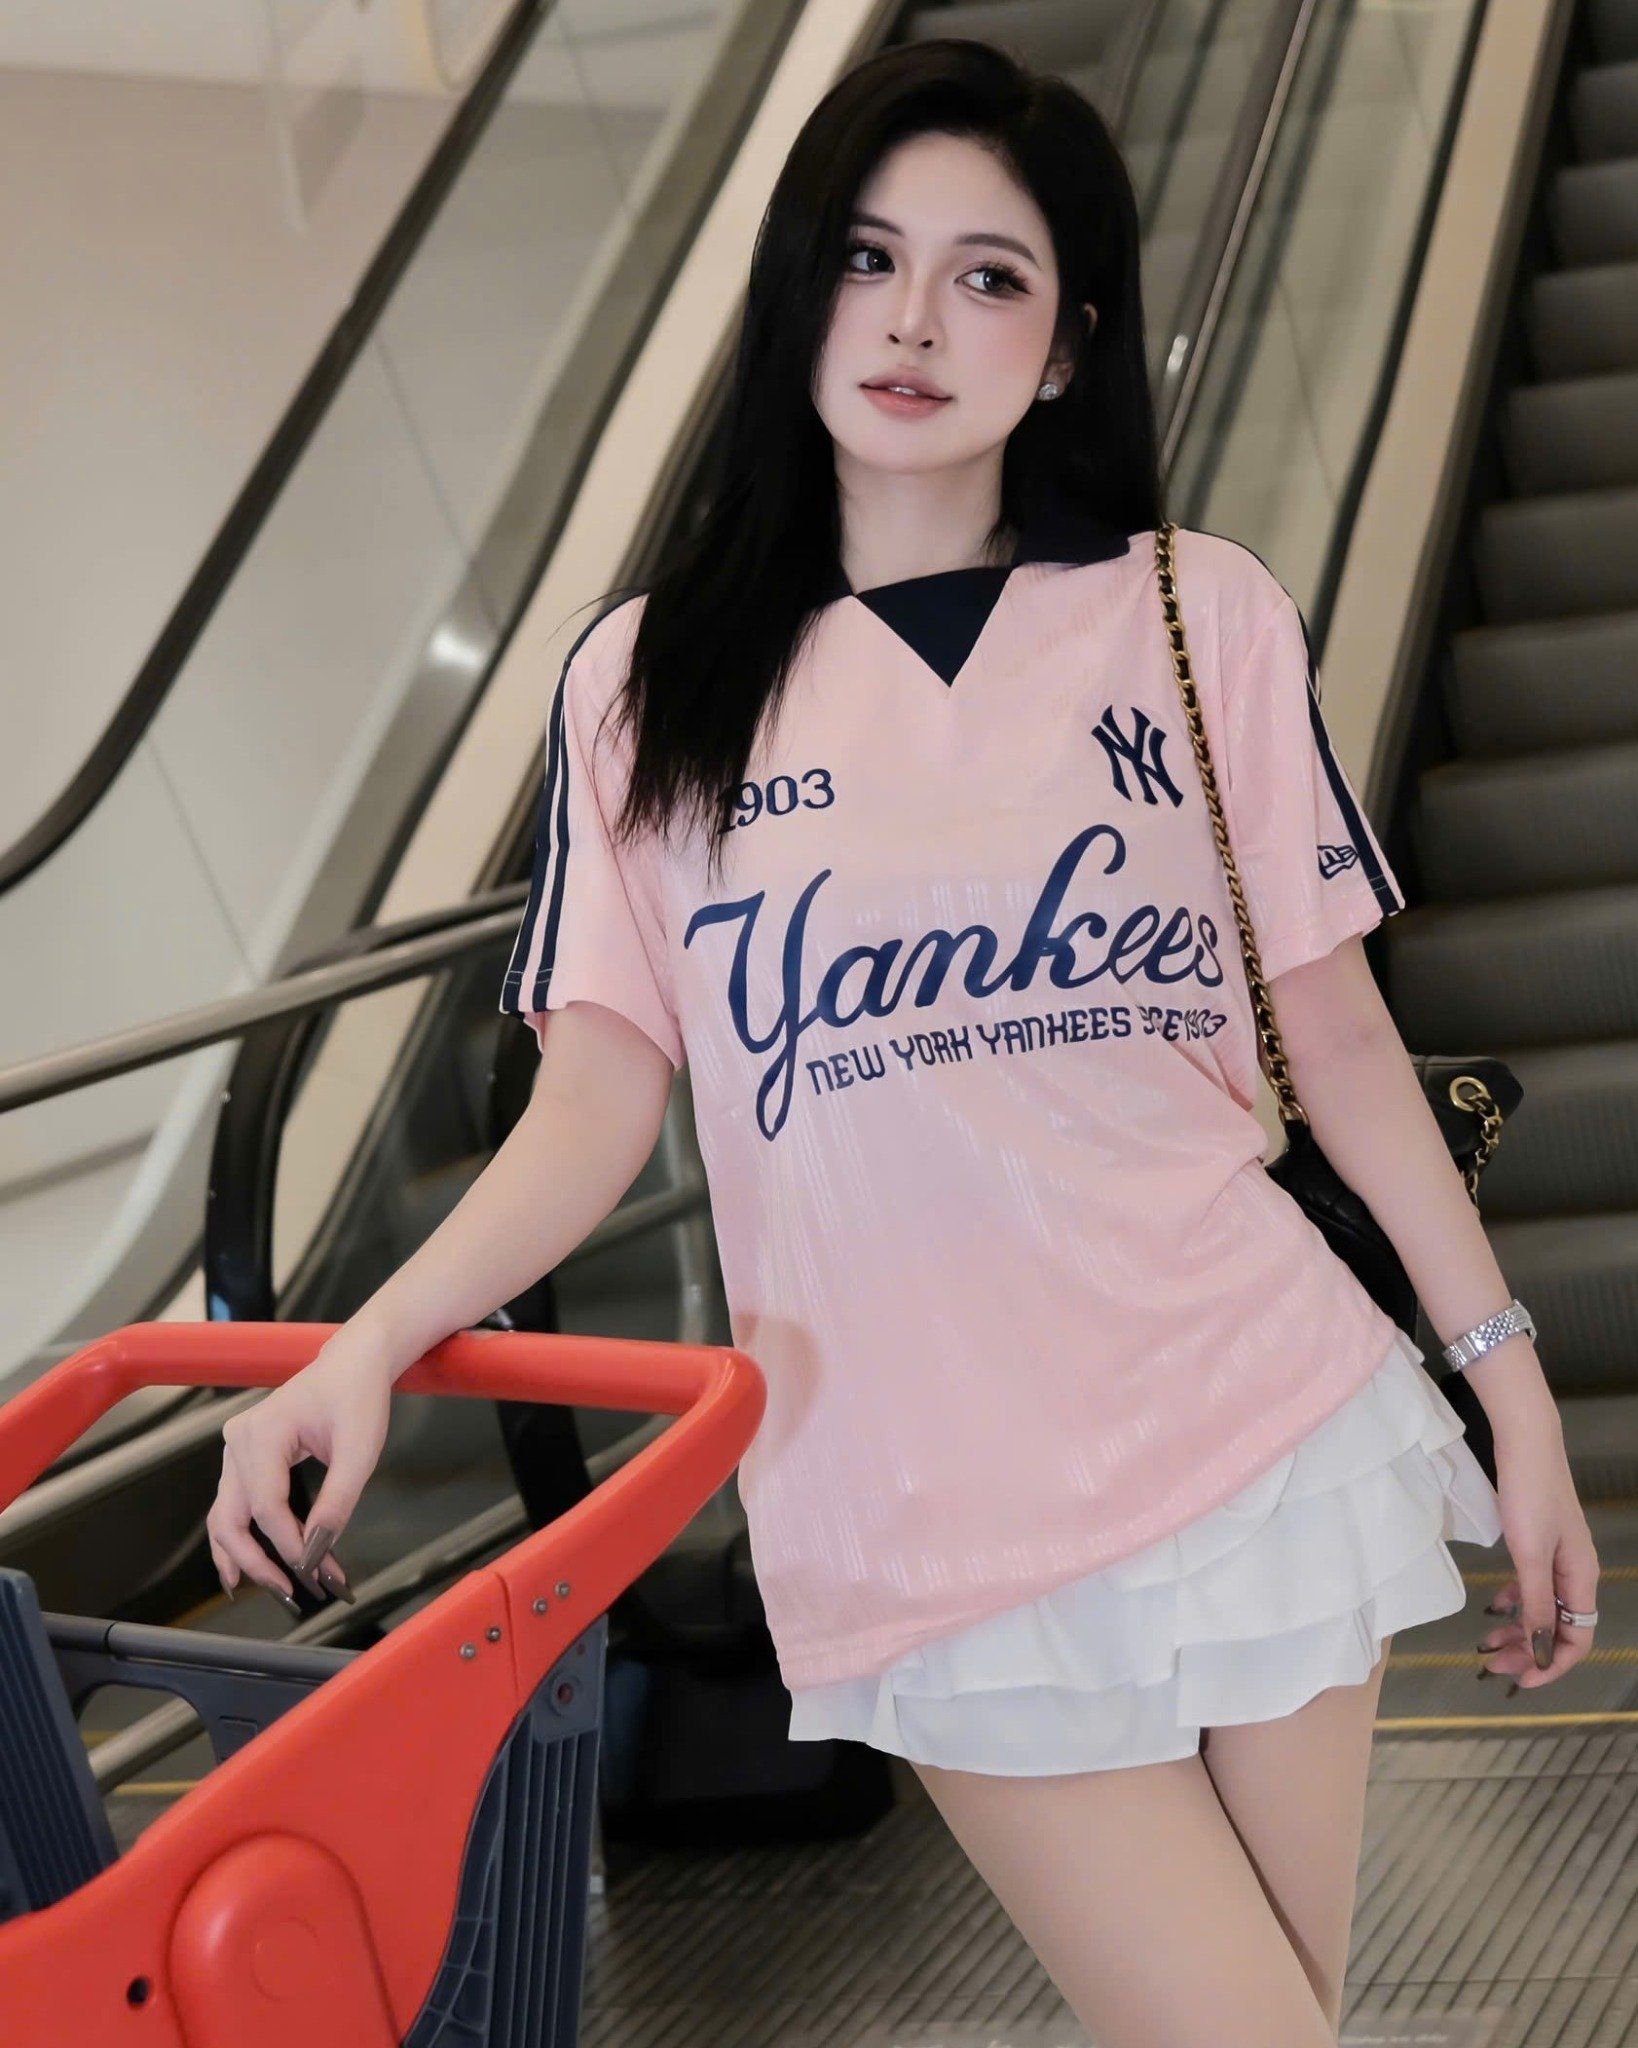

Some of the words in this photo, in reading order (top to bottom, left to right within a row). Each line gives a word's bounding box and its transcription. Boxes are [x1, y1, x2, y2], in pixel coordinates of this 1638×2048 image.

[1091, 704, 1184, 808] NY
[683, 824, 1224, 1142] Yankees
[805, 1043, 886, 1096] NEW
[889, 1025, 973, 1071] YORK
[976, 1006, 1132, 1056] YANKEES
